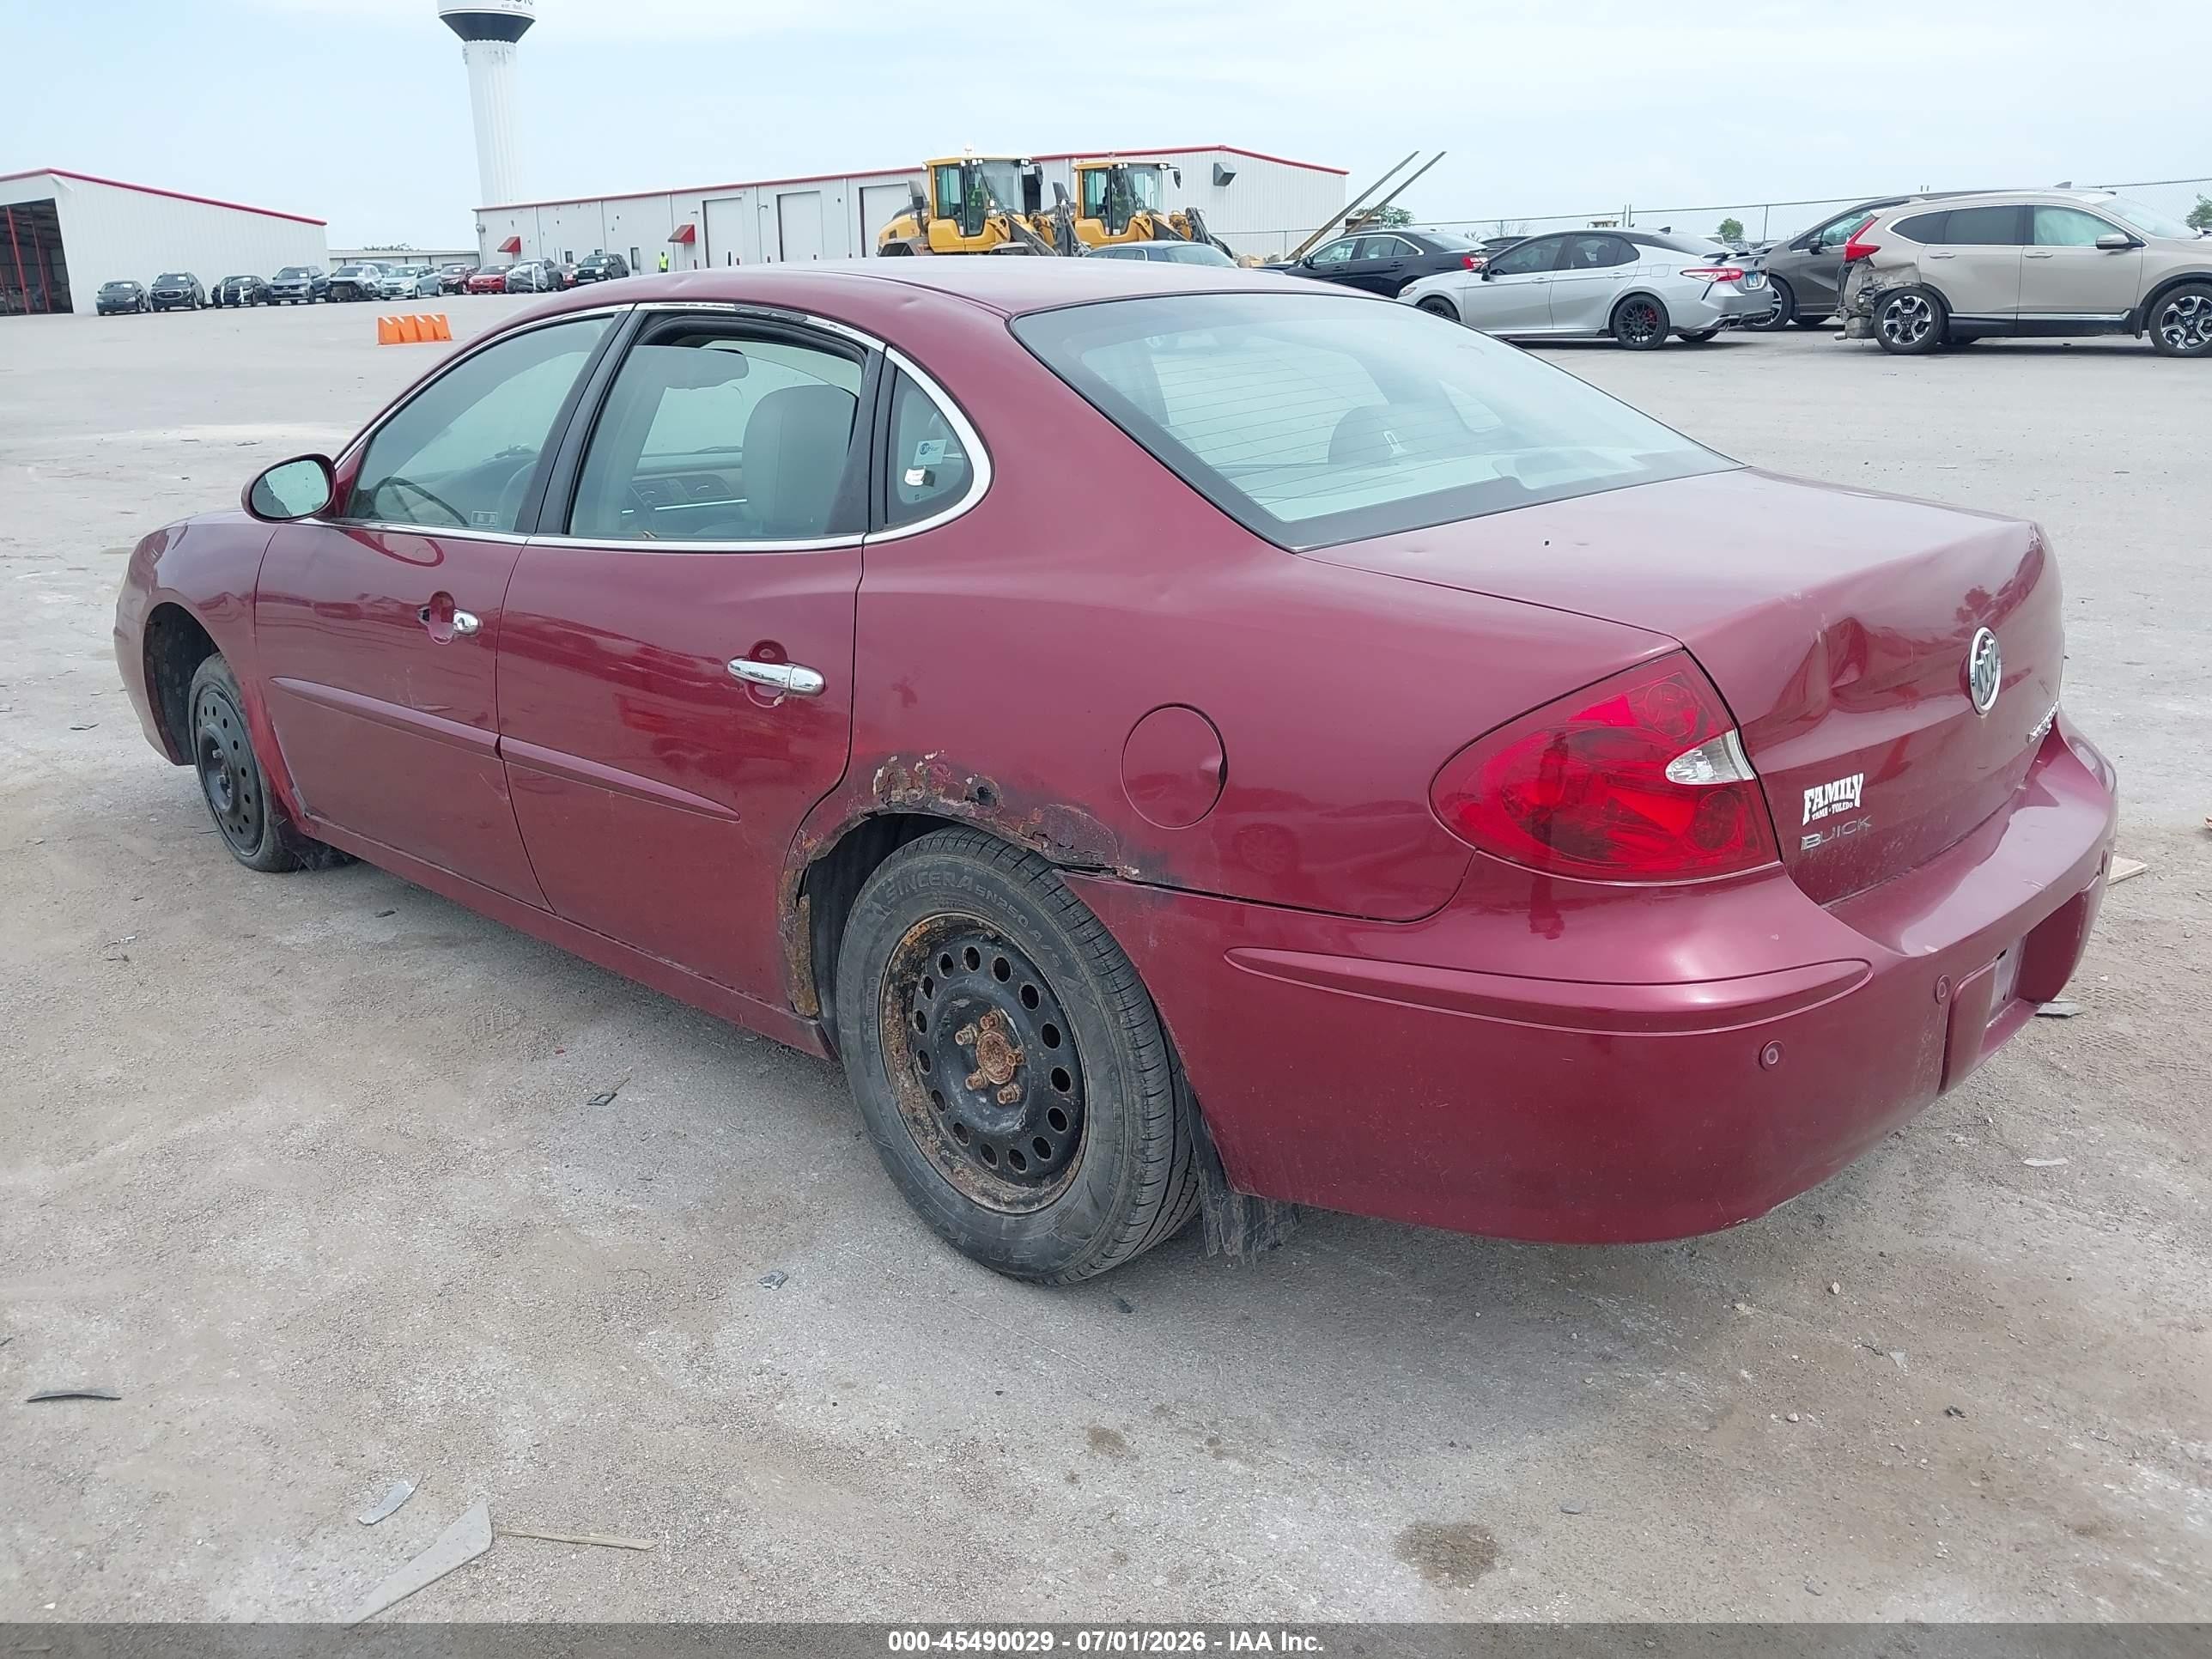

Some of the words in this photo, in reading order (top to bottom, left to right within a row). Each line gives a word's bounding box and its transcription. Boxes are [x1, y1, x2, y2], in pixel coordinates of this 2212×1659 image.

[1802, 773, 1864, 825] FAMILY
[1832, 801, 1853, 815] TOLEDO
[1801, 815, 1872, 850] BUICK
[885, 871, 973, 899] SINCERA
